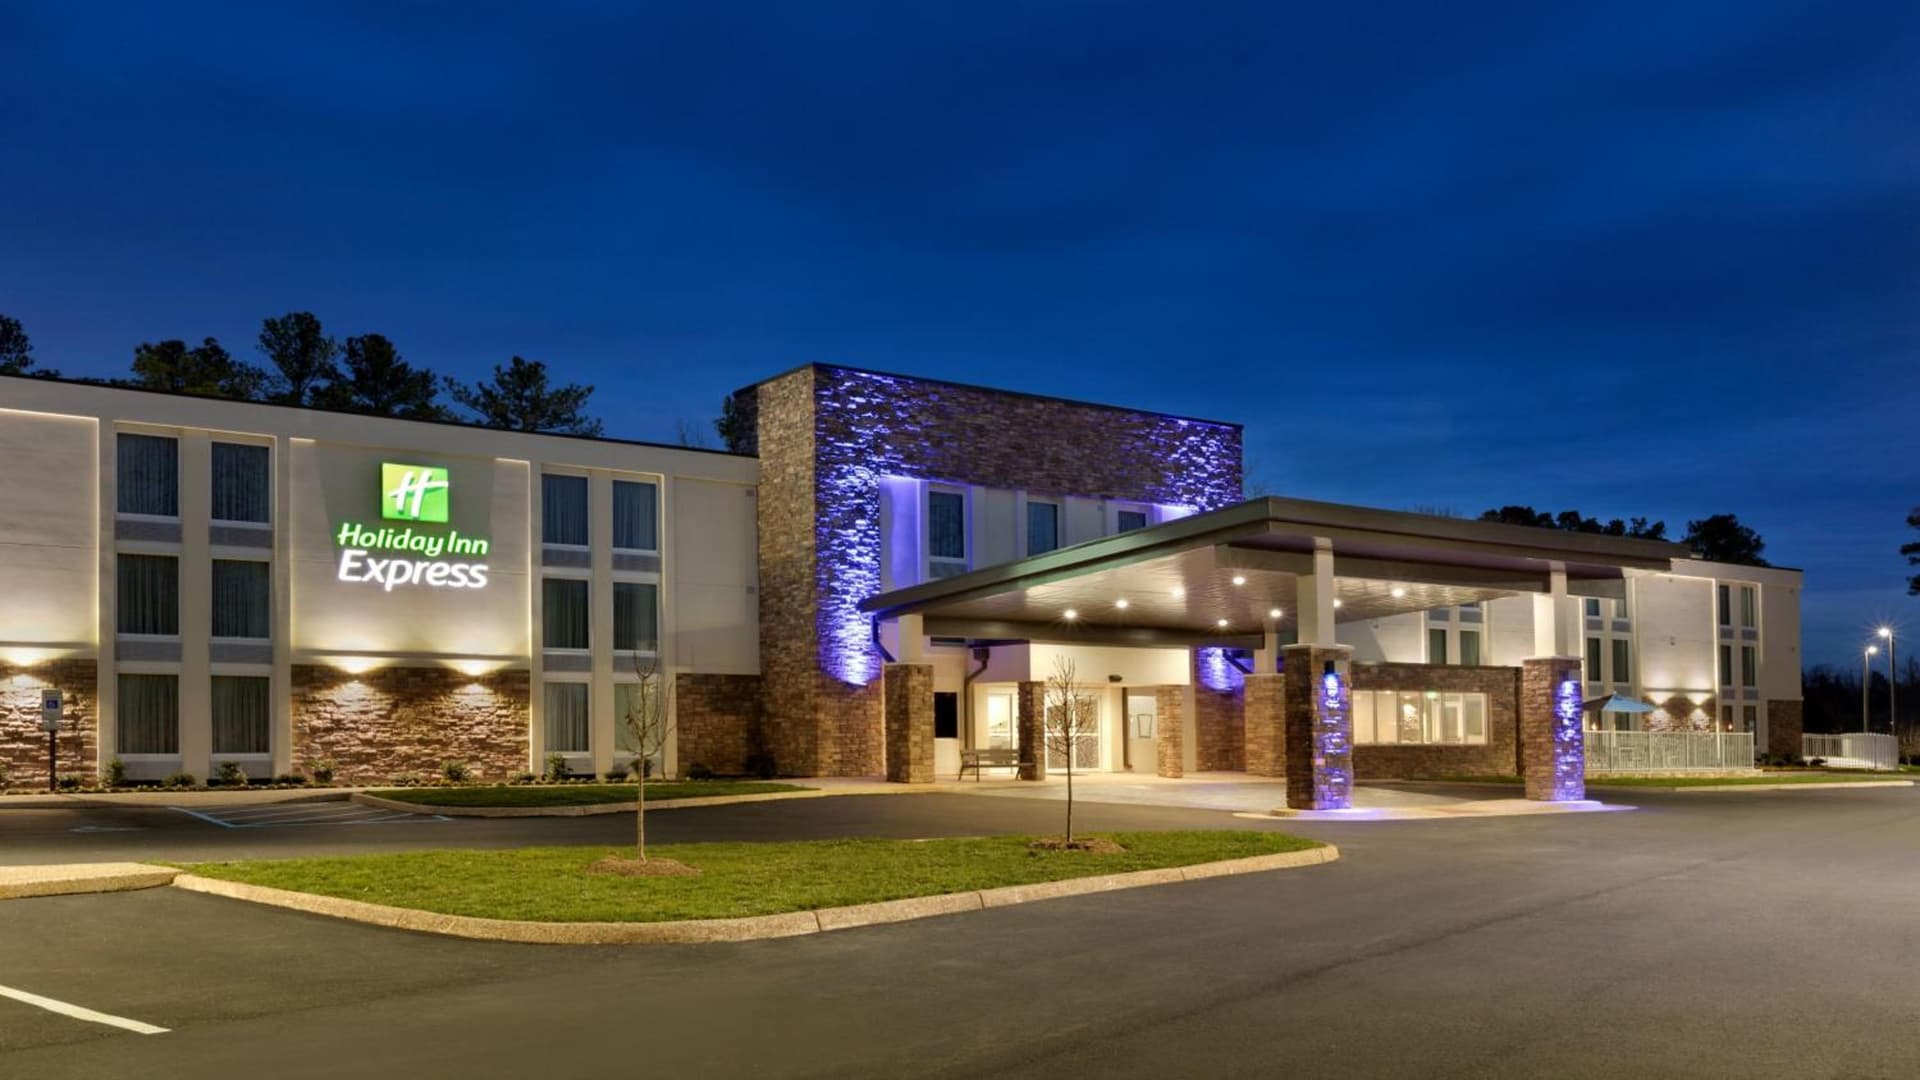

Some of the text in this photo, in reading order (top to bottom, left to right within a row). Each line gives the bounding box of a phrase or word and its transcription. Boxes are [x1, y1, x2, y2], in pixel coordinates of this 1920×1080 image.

[338, 523, 488, 557] Holiday Inn
[338, 549, 488, 592] Express
